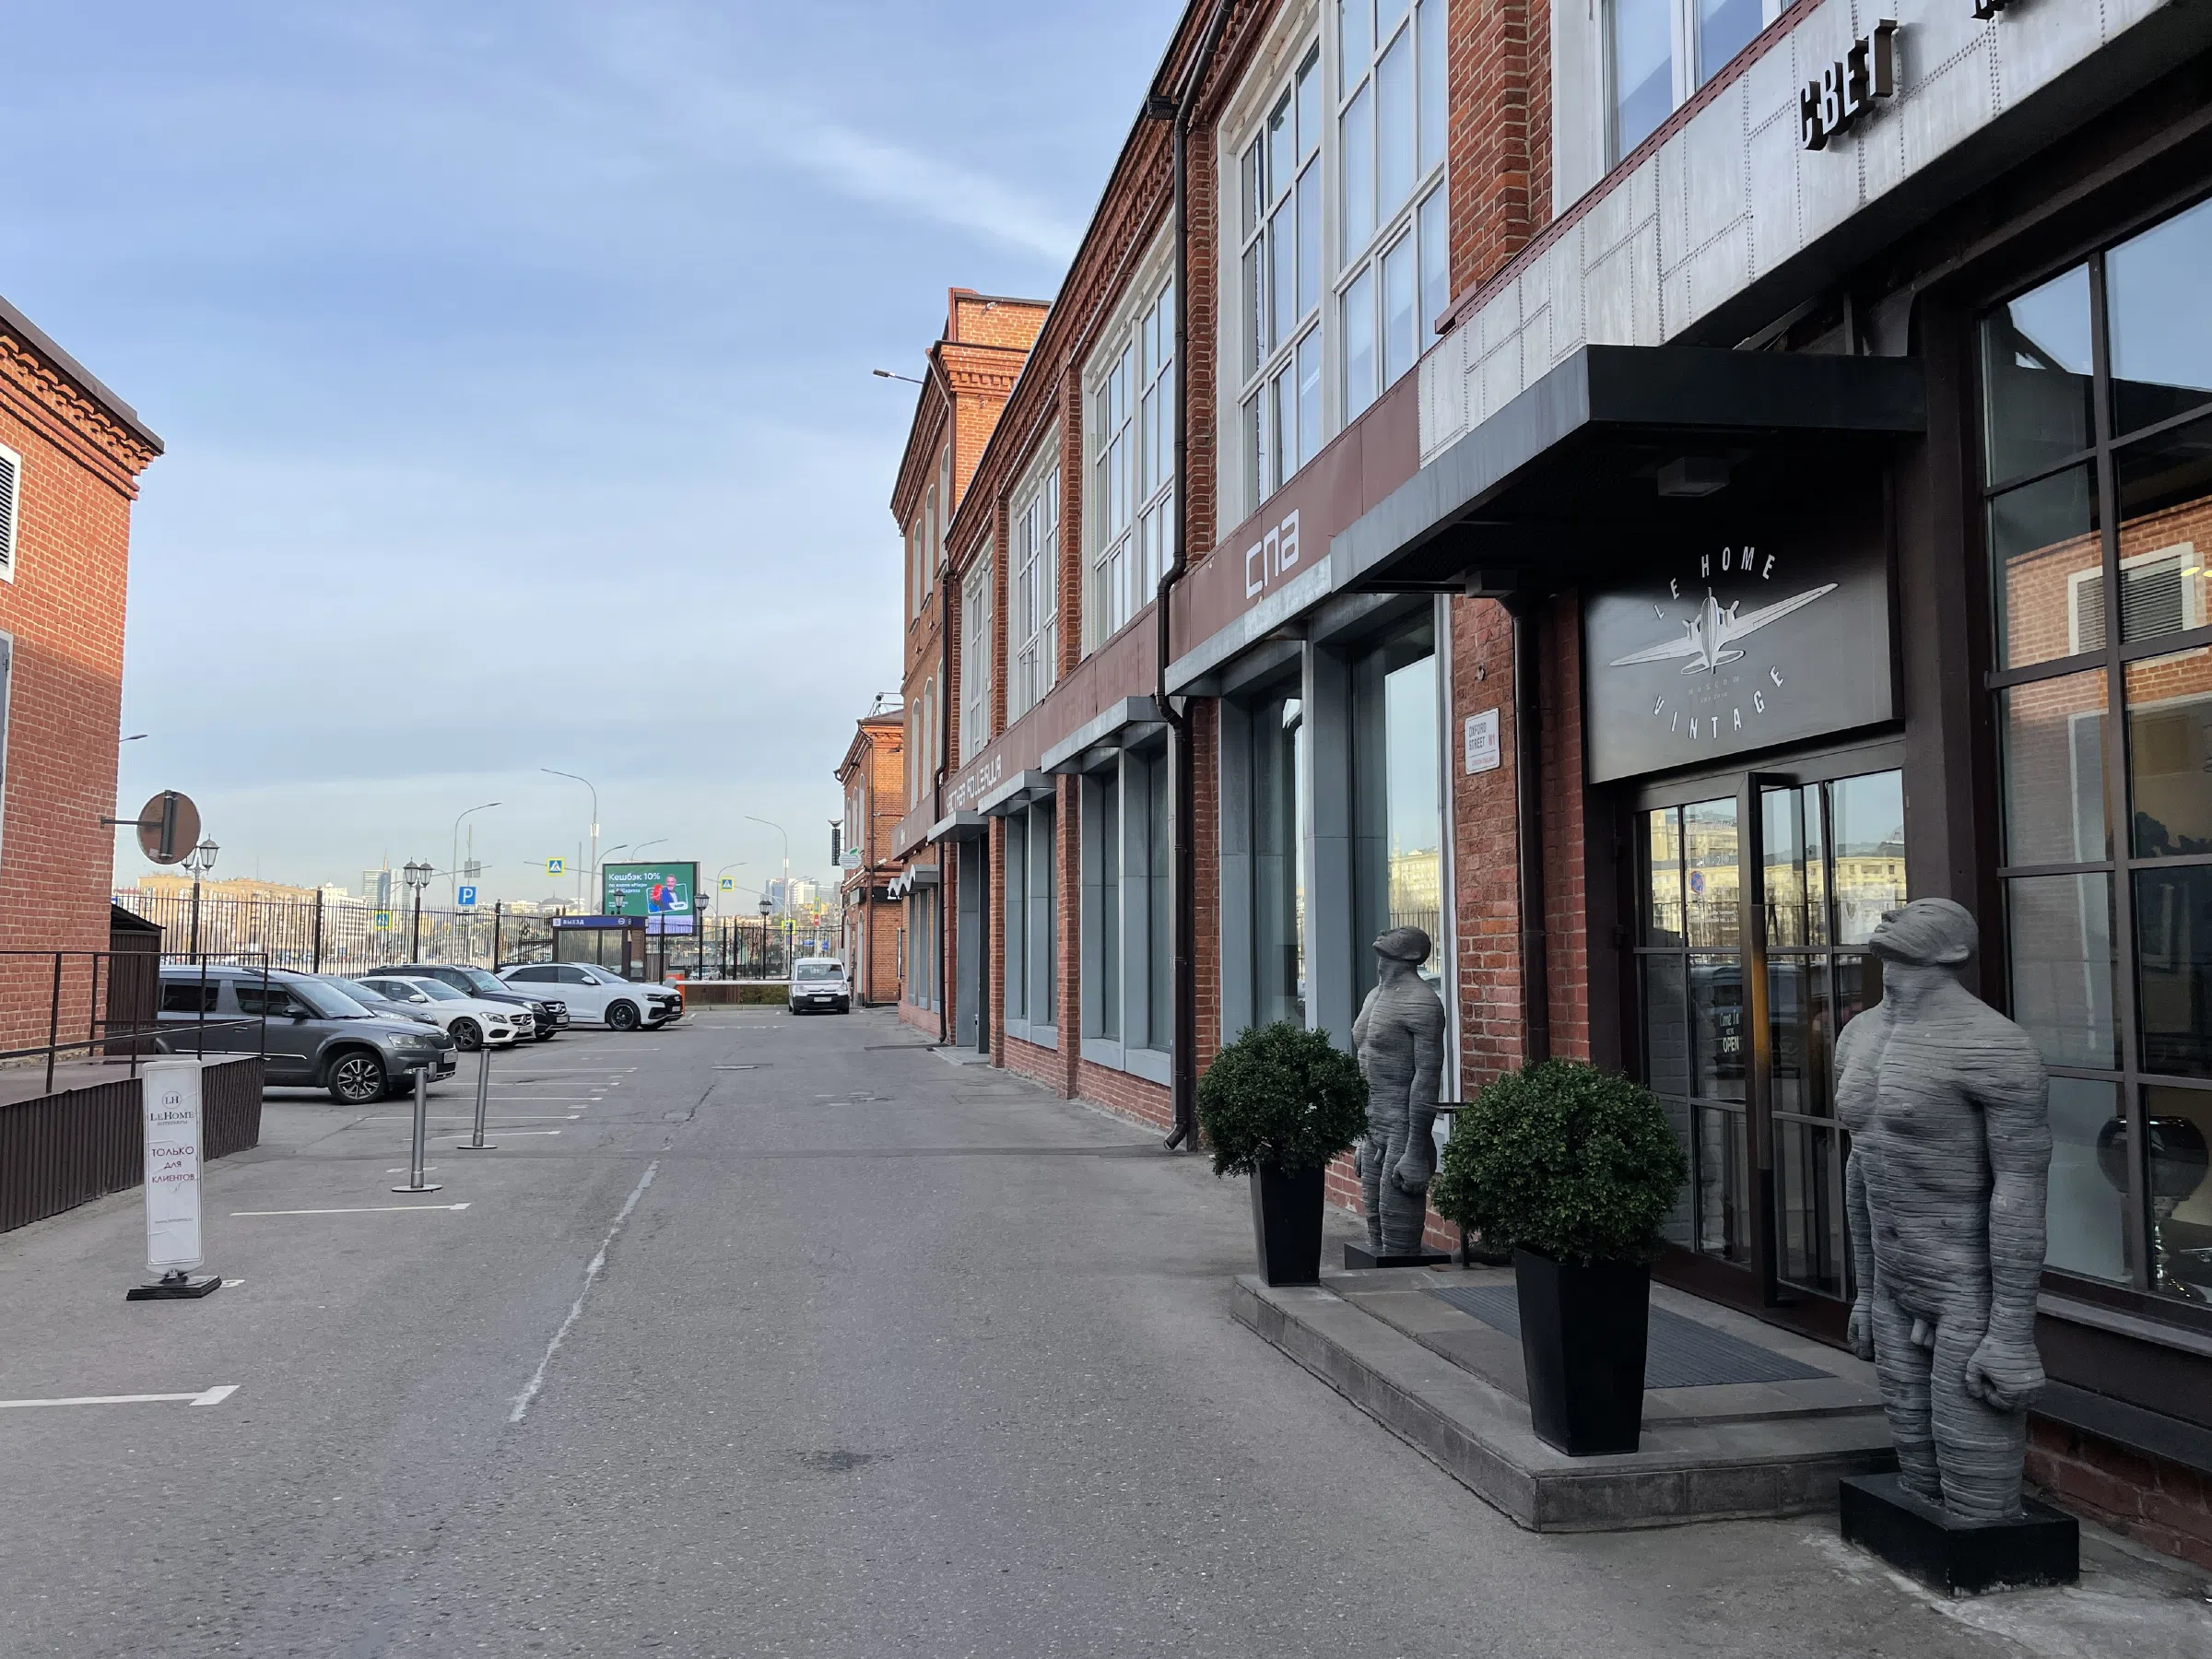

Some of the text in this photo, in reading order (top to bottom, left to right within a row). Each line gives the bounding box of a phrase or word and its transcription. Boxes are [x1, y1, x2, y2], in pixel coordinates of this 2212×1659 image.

[1798, 18, 1897, 151] СВЕТ
[1653, 547, 1776, 620] LE HOME
[1653, 665, 1785, 739] VINTAGE
[1469, 722, 1487, 737] OXFORD
[1469, 735, 1486, 750] STREET
[608, 872, 661, 881] Кешбэк 10%
[1723, 1036, 1739, 1053] OPEN
[165, 1096, 179, 1105] LH
[151, 1147, 194, 1158] ТОЛЬКО
[164, 1160, 182, 1170] ДЛЯ
[151, 1173, 195, 1183] КЛИЕНТОВ
